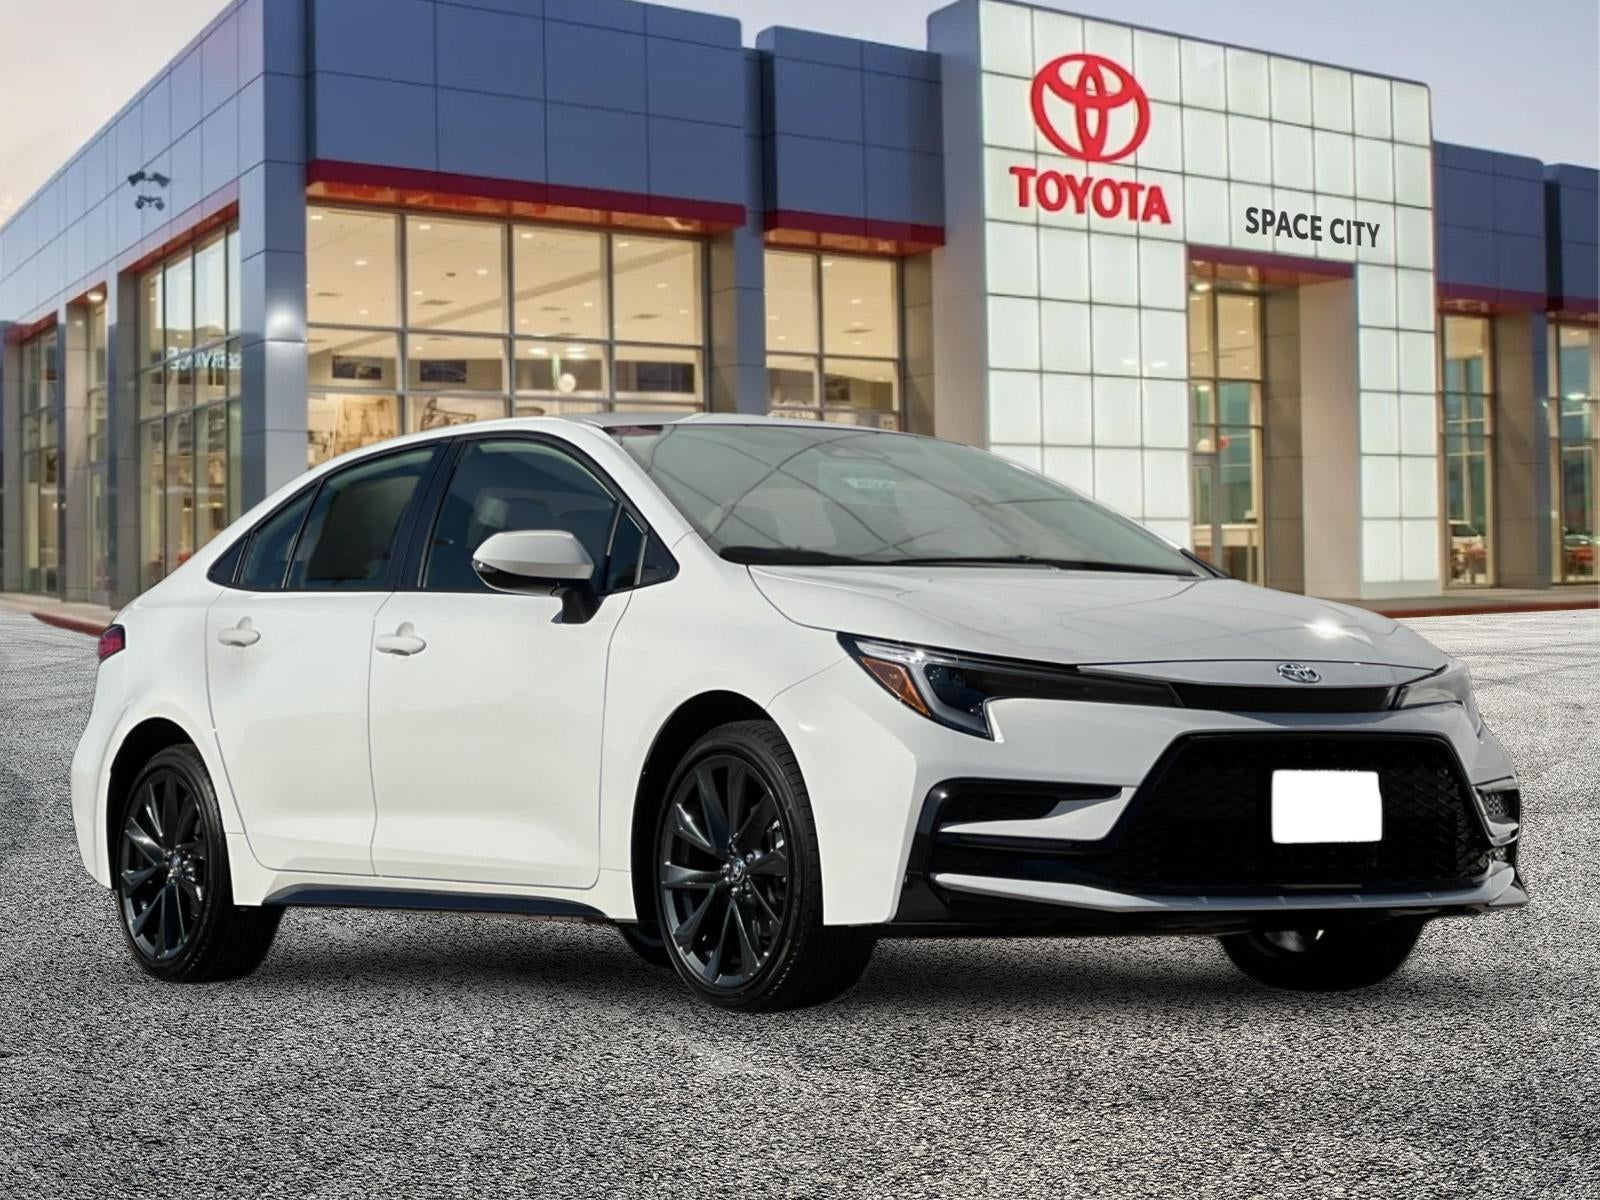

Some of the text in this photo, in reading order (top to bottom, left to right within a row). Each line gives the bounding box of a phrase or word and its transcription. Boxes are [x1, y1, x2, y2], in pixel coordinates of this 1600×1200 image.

[1009, 166, 1171, 225] TOYOTA
[1245, 206, 1381, 248] SPACE CITY
